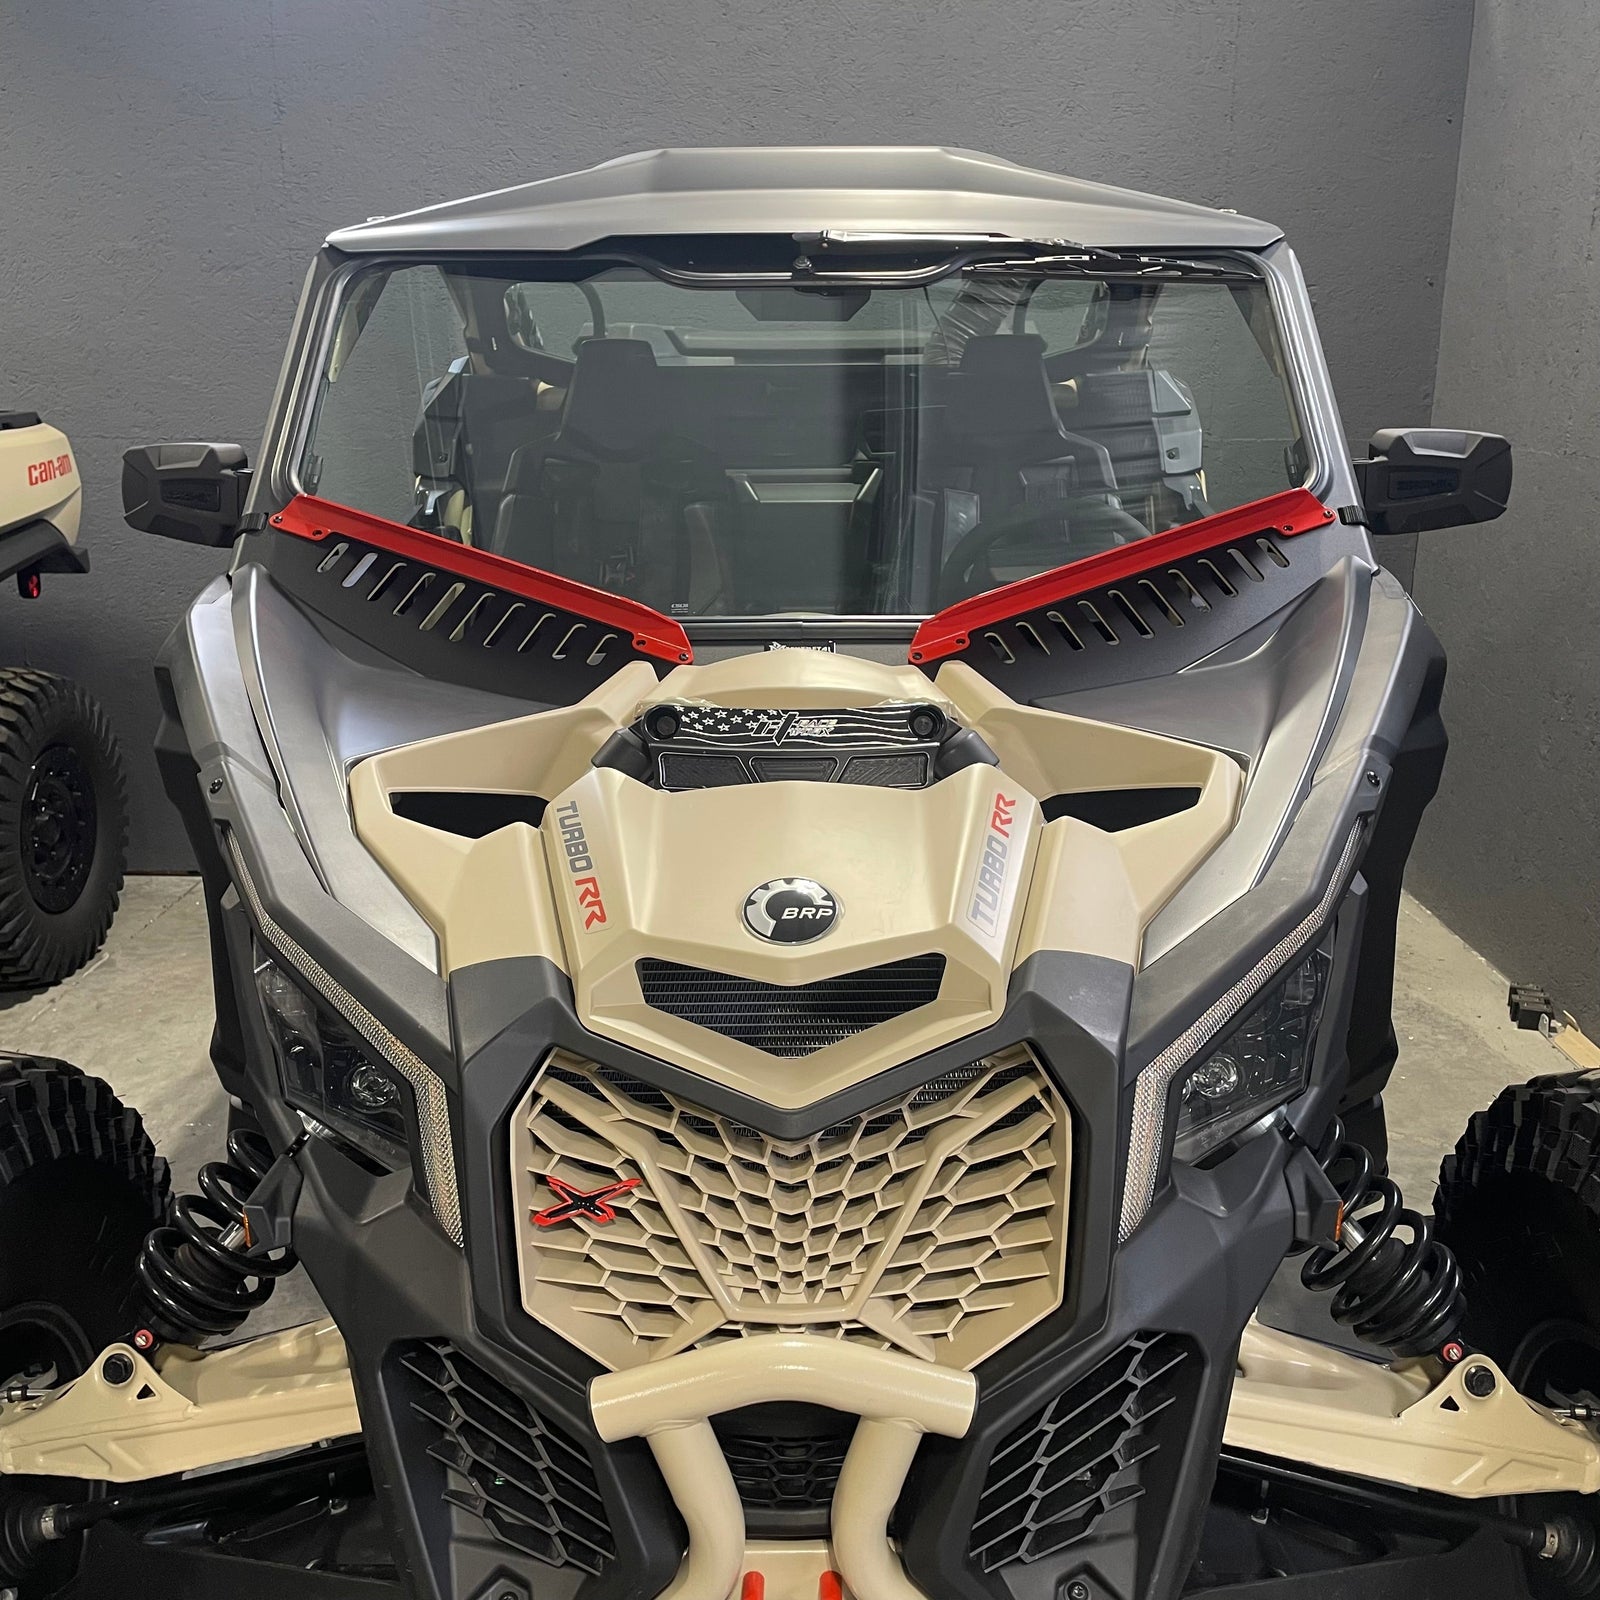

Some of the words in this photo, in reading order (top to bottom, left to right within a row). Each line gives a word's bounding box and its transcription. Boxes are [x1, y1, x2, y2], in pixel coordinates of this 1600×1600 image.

[28, 453, 72, 486] can-am
[556, 800, 593, 873] TURBO
[971, 834, 1008, 926] TURBO
[990, 793, 1017, 838] RR
[574, 876, 607, 930] RR
[781, 907, 833, 920] BRP
